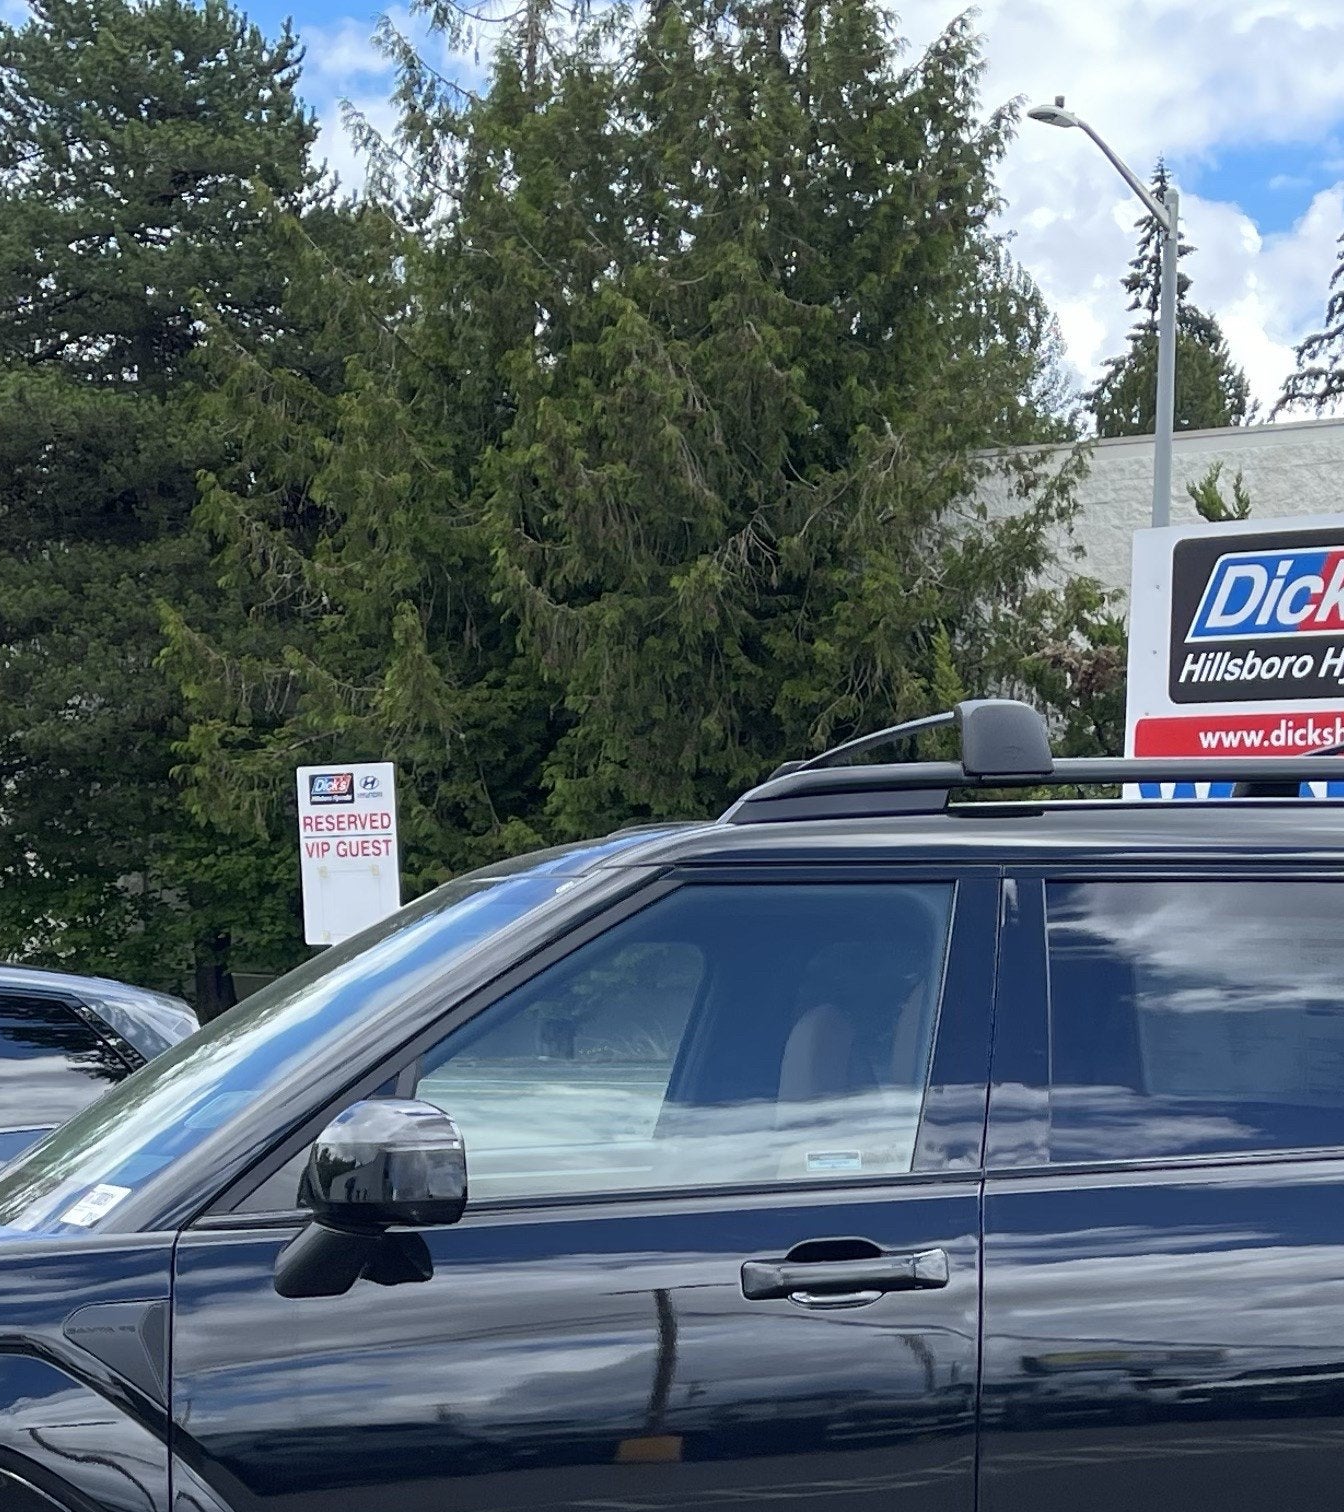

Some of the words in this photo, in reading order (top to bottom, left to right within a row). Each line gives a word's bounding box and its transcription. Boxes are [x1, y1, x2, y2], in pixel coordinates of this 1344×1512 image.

[1178, 650, 1314, 684] Hillsboro
[303, 813, 391, 832] RESERVED
[305, 842, 330, 858] VIP
[336, 839, 392, 858] GUEST
